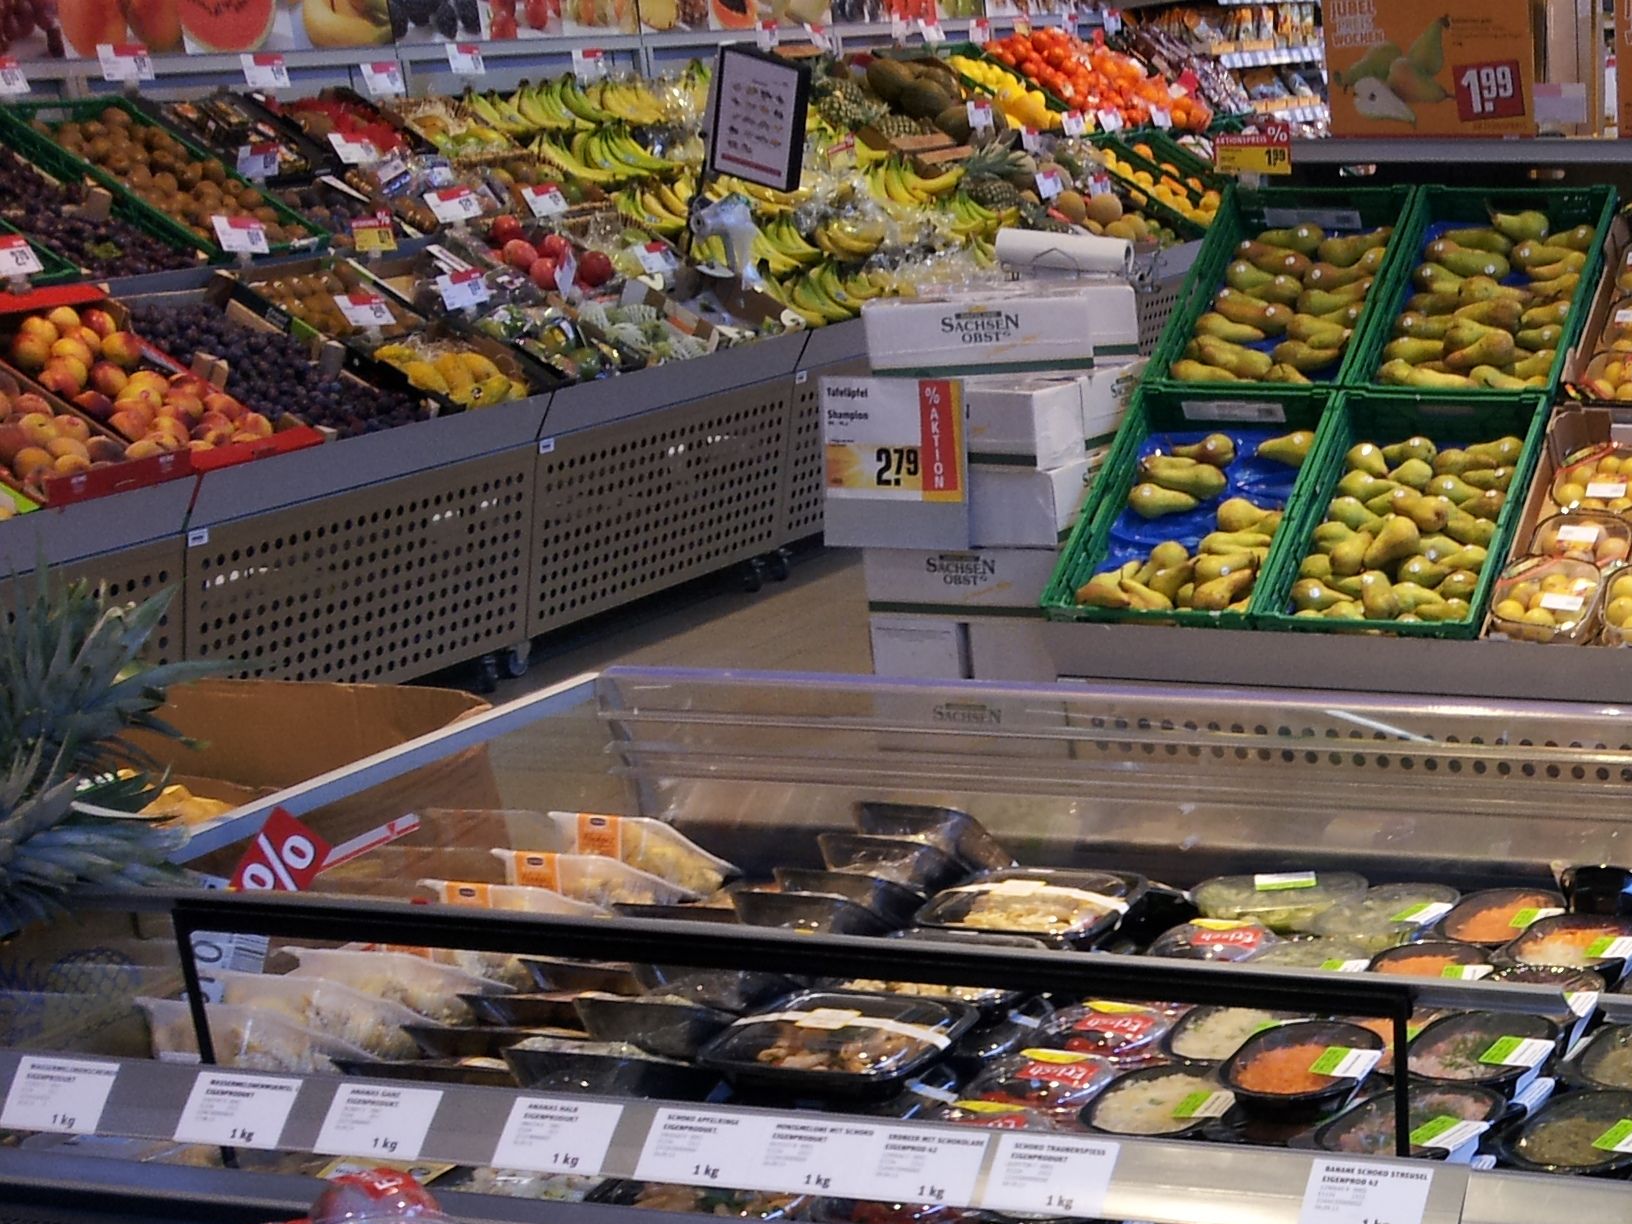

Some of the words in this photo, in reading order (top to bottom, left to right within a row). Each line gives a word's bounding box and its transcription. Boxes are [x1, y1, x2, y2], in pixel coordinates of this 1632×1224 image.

[1461, 66, 1513, 115] 1.99
[941, 314, 1019, 333] SACHSEN
[962, 331, 1000, 344] OBST
[826, 387, 868, 398] Tafeläpfel
[828, 410, 868, 421] Shampion
[930, 408, 945, 490] AKTION
[876, 447, 918, 487] 2.79
[926, 558, 995, 574] SACHSEN
[943, 573, 979, 585] OBST
[53, 1115, 58, 1124] 1
[61, 1114, 76, 1128] kg
[230, 1128, 238, 1139] 1
[240, 1128, 254, 1142] kg
[373, 1137, 379, 1148] 1
[383, 1138, 398, 1152] kg
[553, 1153, 559, 1164] 1
[563, 1154, 579, 1168] kg
[693, 1164, 700, 1175] 1
[704, 1166, 719, 1179] kg
[1357, 1168, 1389, 1177] SCHOKO
[805, 1174, 811, 1185] 1
[815, 1175, 831, 1189] kg
[919, 1185, 925, 1196] 1
[929, 1186, 944, 1200] kg
[1047, 1195, 1053, 1206] 1
[1057, 1197, 1073, 1211] kg
